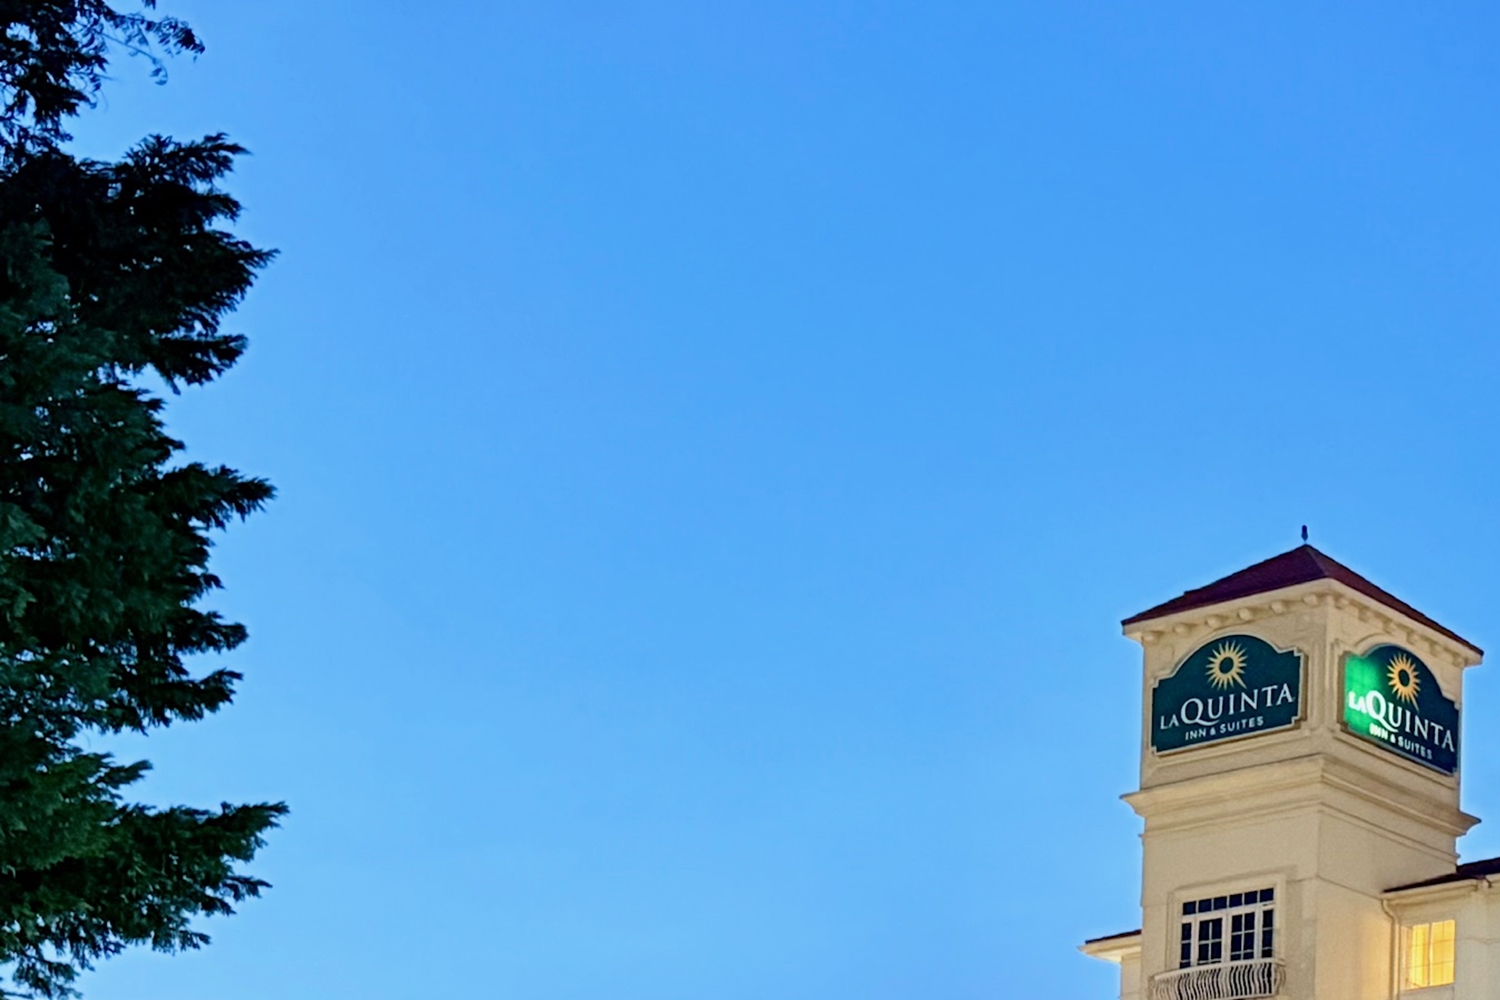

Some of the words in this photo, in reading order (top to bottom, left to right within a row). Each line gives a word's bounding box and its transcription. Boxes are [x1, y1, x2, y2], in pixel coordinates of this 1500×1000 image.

[1160, 714, 1180, 730] LA
[1180, 683, 1294, 726] QUINTA
[1348, 690, 1367, 714] LA
[1365, 690, 1455, 752] QUINTA
[1185, 728, 1207, 741] INN
[1219, 716, 1264, 734] SUITES
[1369, 722, 1389, 740] INN
[1397, 736, 1433, 760] SUITES
